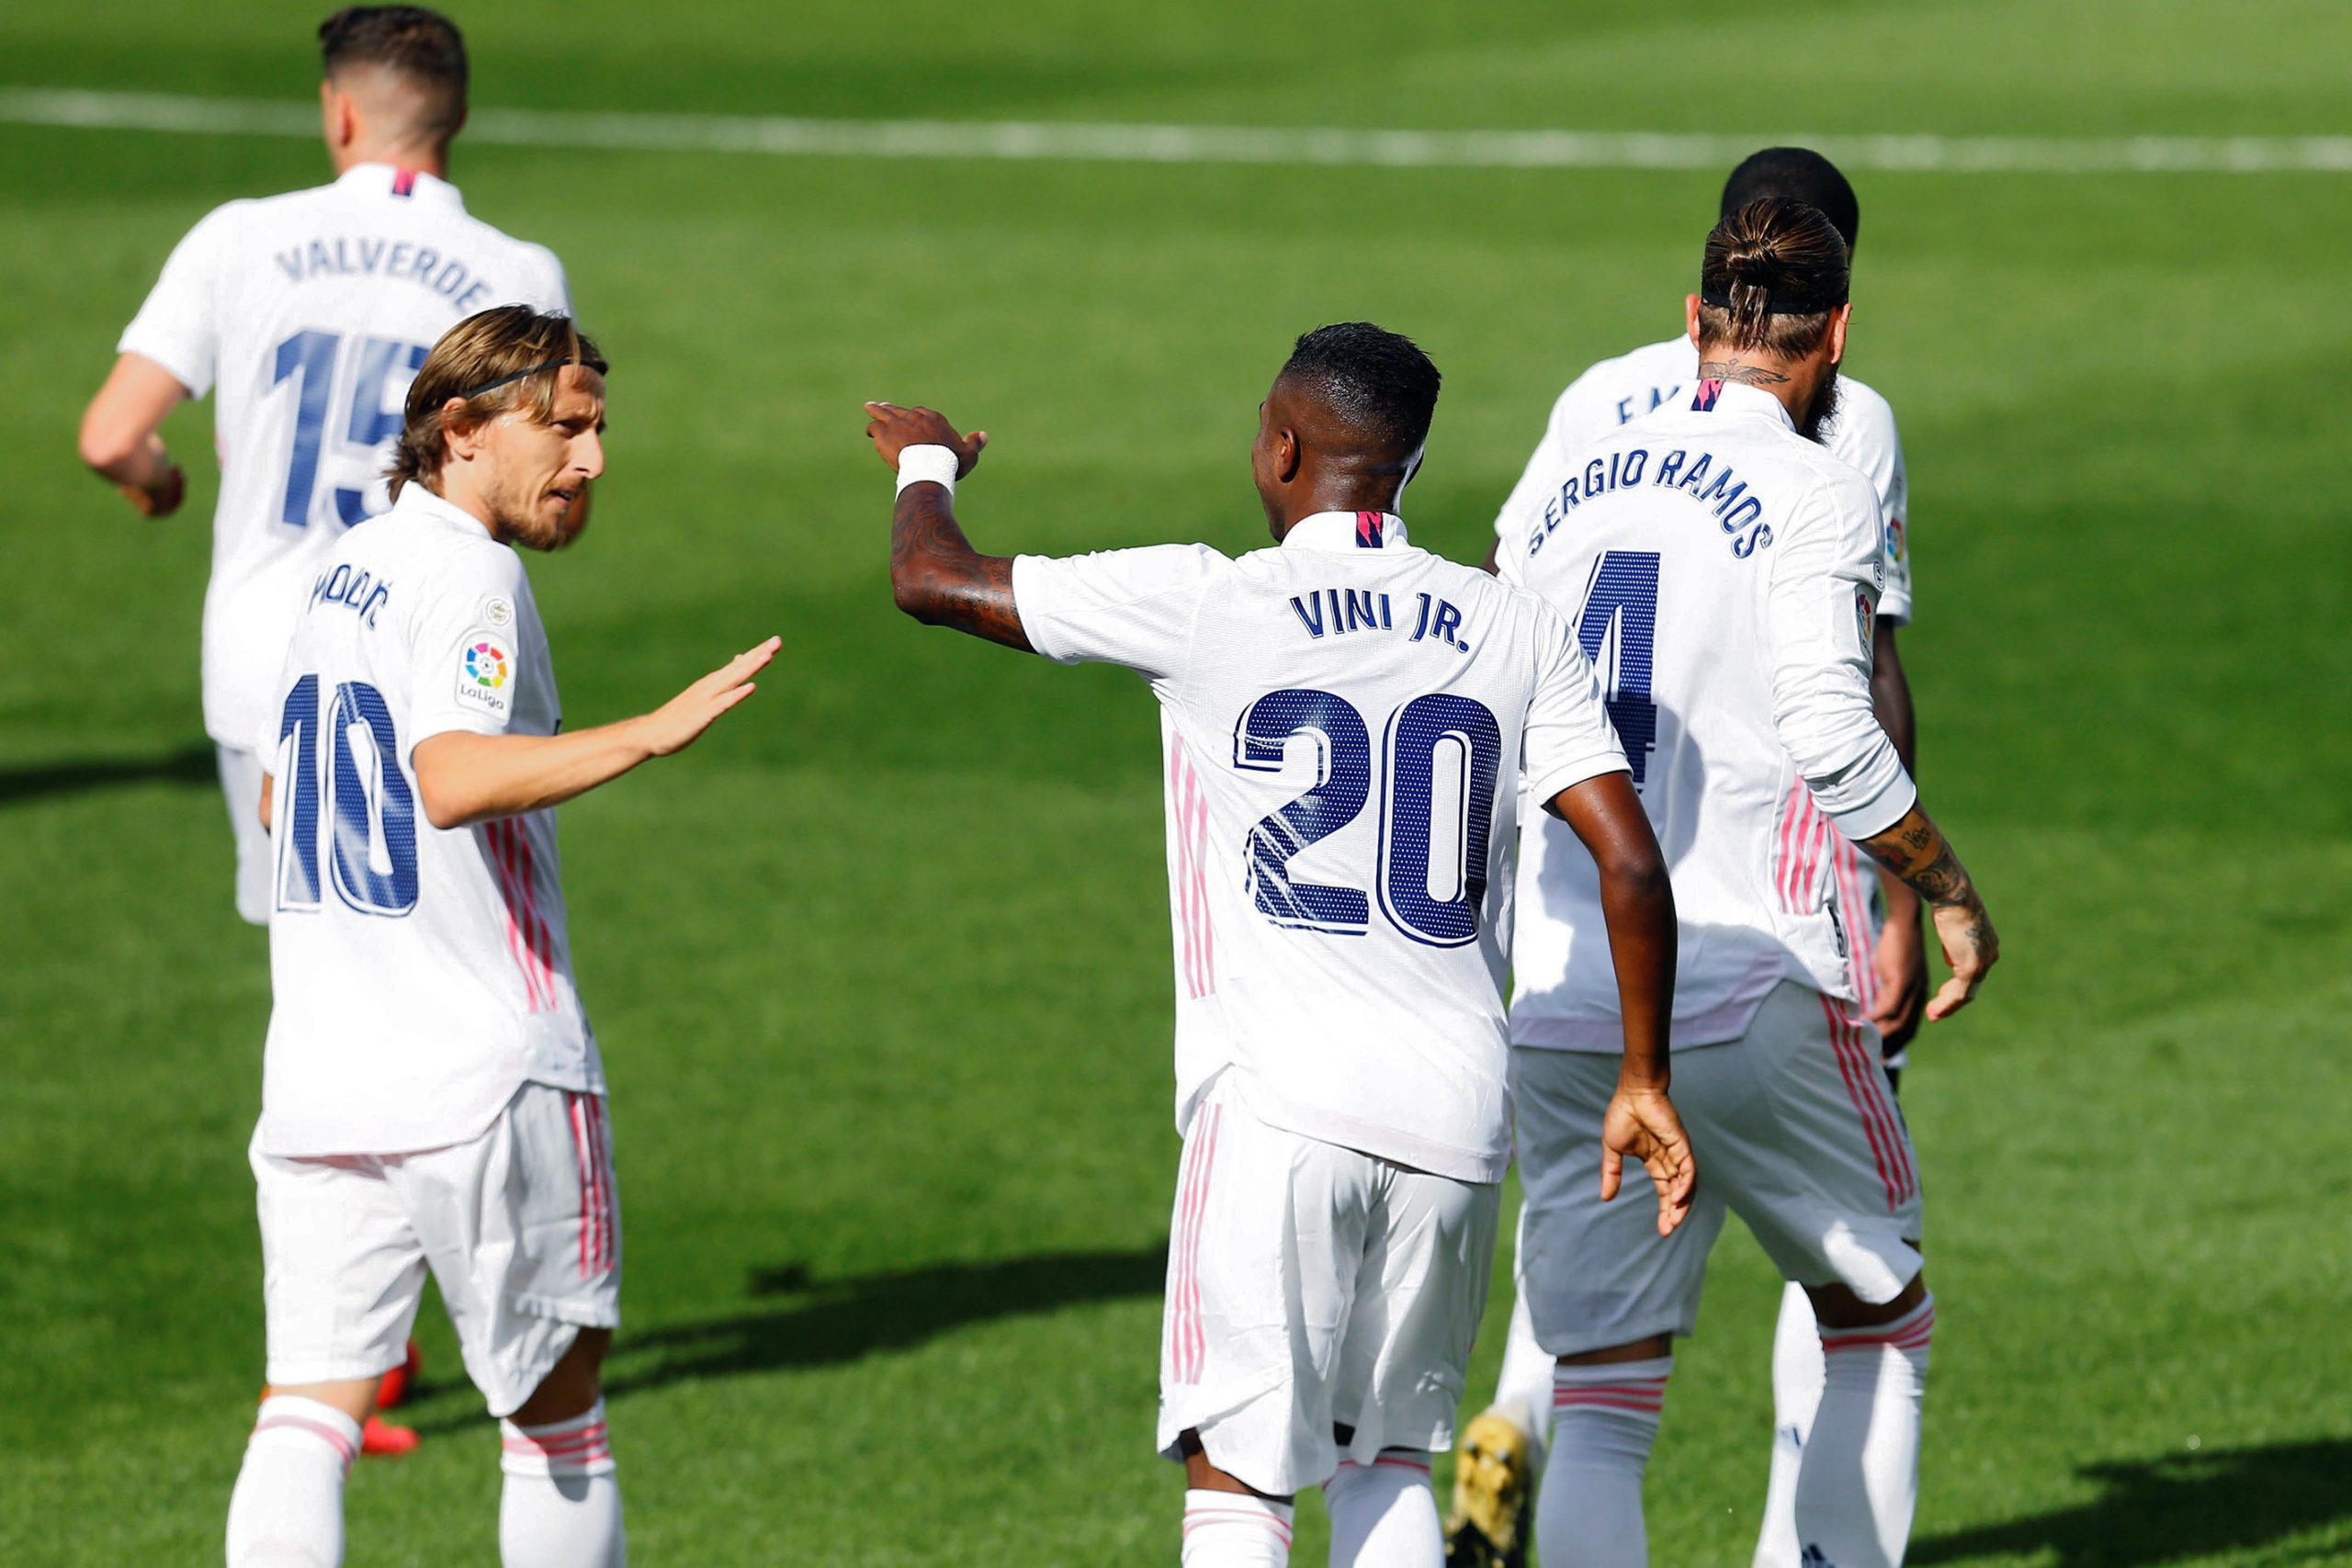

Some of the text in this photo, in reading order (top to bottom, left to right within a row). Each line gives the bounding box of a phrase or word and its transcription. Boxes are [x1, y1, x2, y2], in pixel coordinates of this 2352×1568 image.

[275, 236, 492, 314] VALVERDE
[269, 329, 430, 530] 15
[1528, 449, 1774, 559] SERGIO RAMOS
[460, 684, 504, 710] LaLiga
[1290, 588, 1469, 653] VINI JR.
[1572, 550, 1661, 794] 4
[277, 674, 421, 918] 10
[1233, 689, 1501, 948] 20
